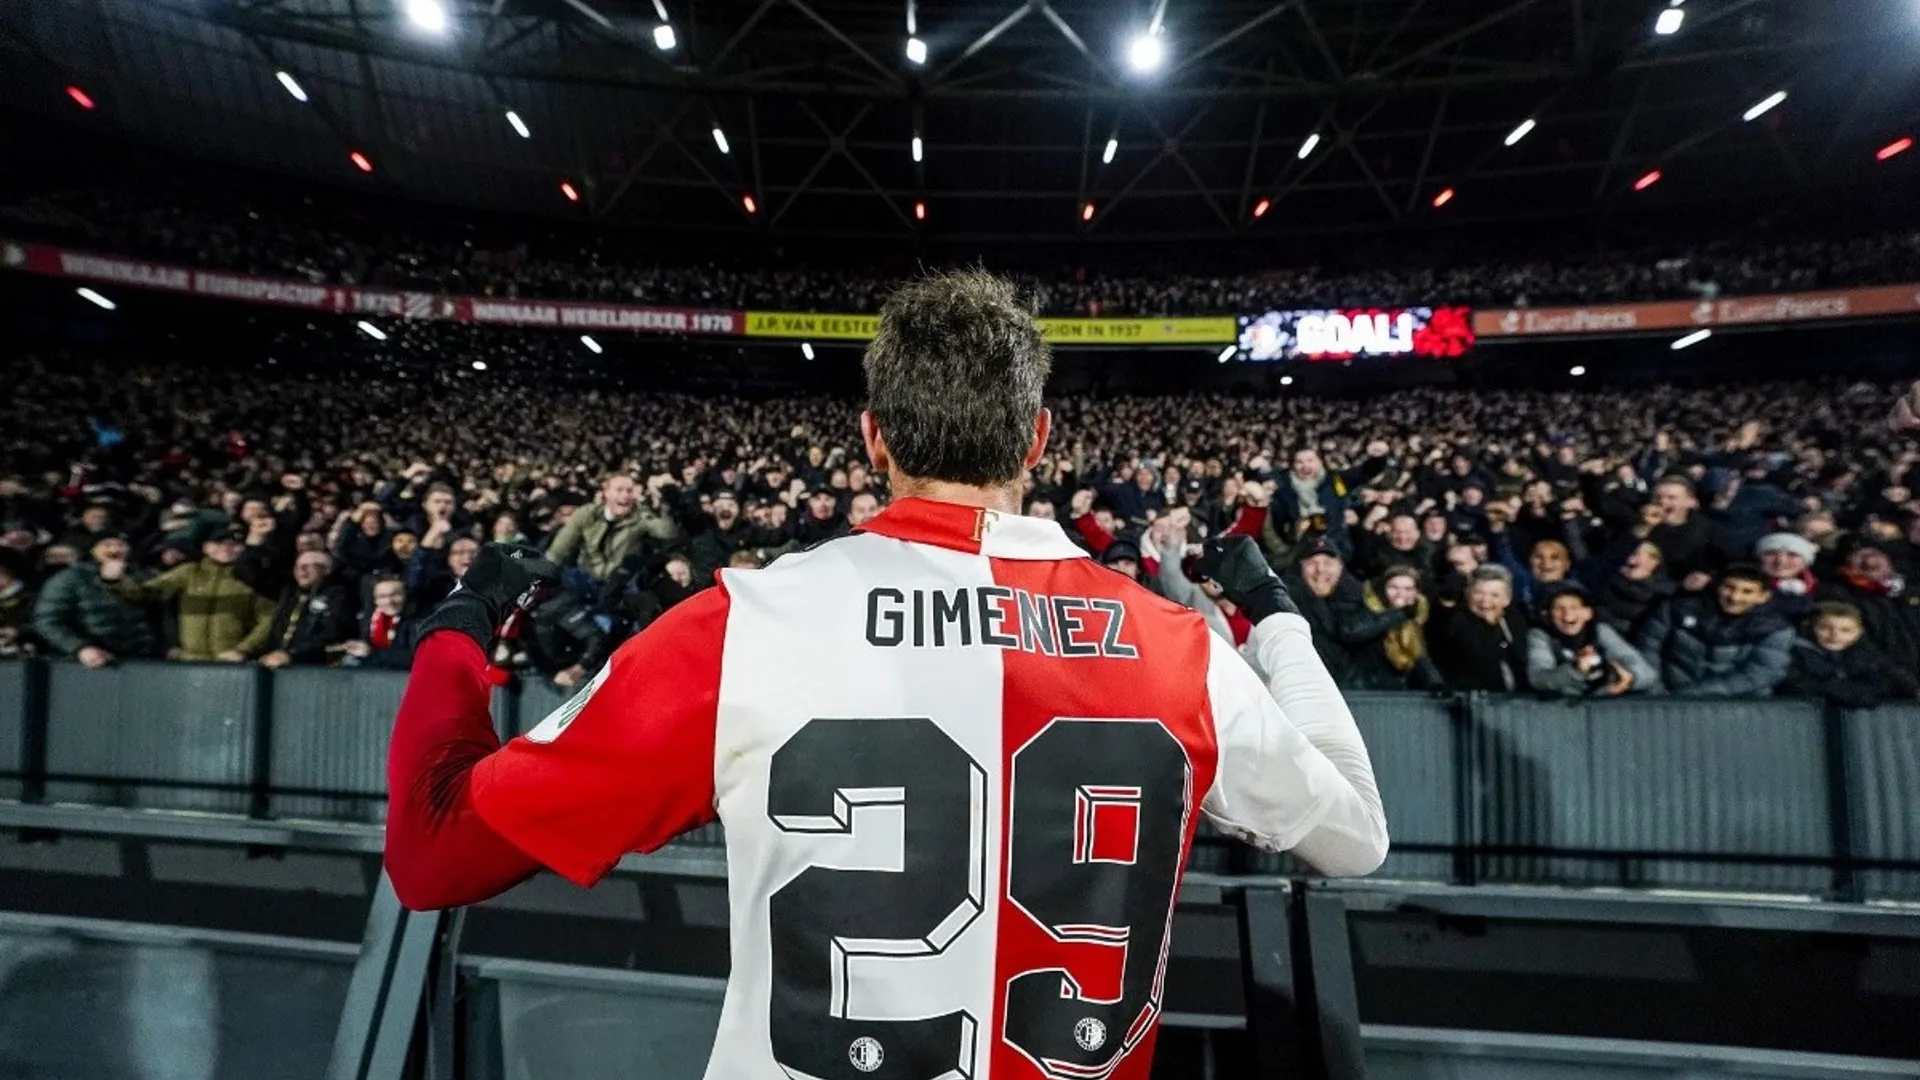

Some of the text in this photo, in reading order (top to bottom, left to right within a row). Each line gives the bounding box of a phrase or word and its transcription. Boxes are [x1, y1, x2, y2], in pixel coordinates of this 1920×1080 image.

[471, 300, 733, 331] WINNAAR WERELDBEKER 1970
[782, 318, 816, 332] VAN
[1087, 323, 1104, 337] IN
[1109, 322, 1142, 337] 1937
[970, 509, 1000, 541] F
[866, 586, 1139, 659] GIMENEZ
[767, 717, 1191, 1080] 29
